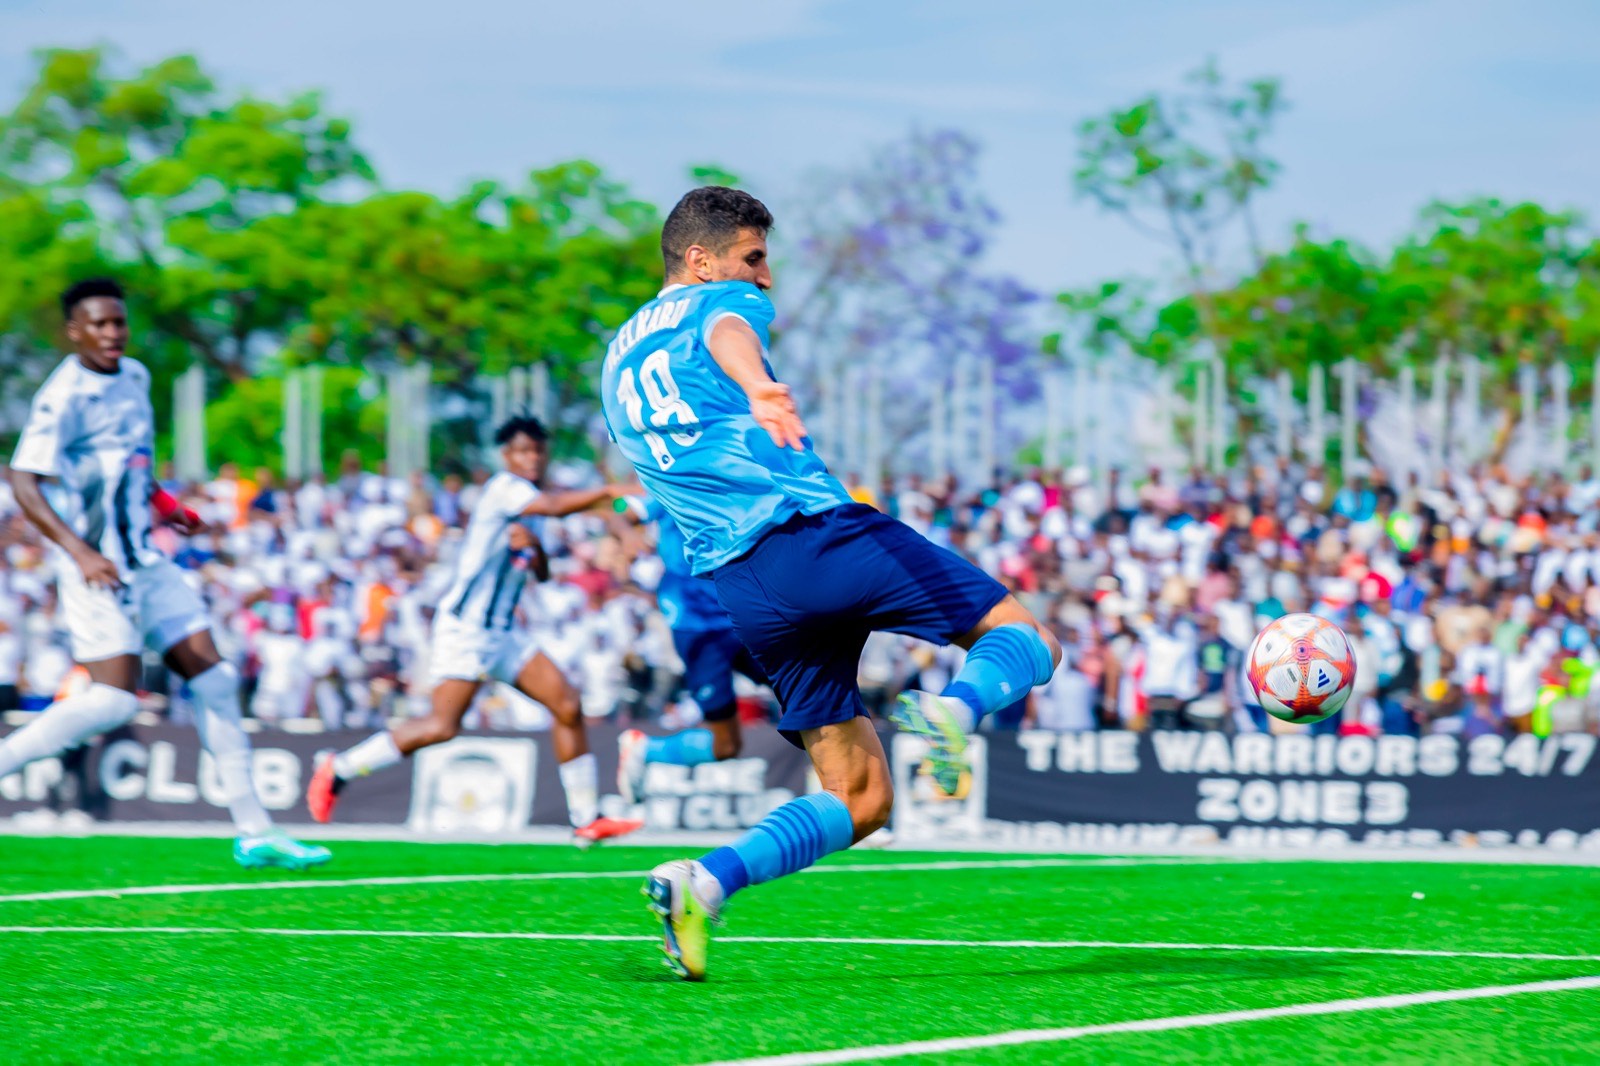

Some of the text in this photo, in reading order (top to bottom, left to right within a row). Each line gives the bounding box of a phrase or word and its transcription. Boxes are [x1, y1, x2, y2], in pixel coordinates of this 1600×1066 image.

[616, 348, 703, 471] 18
[1017, 730, 1597, 776] THE WARRIORS 24/7
